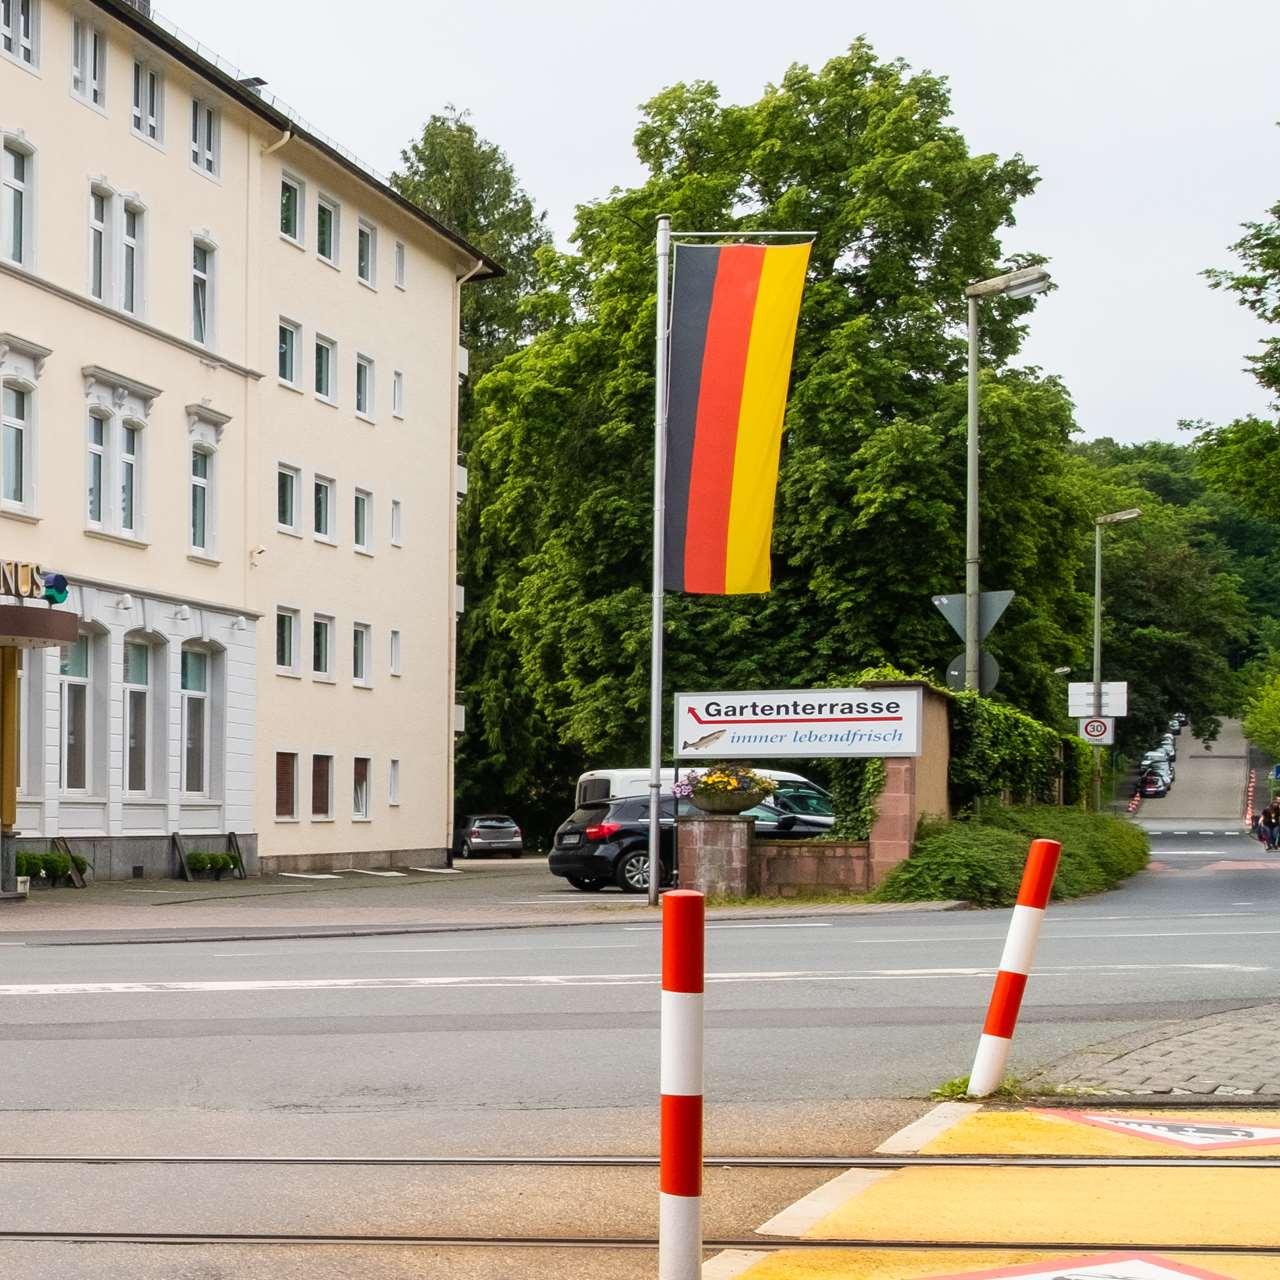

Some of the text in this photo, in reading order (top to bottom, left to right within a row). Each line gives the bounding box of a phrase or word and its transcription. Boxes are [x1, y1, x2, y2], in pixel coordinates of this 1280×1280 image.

[704, 700, 901, 718] Gartenterrasse
[730, 728, 904, 747] immer lebendfrisch
[1089, 724, 1103, 733] 30
